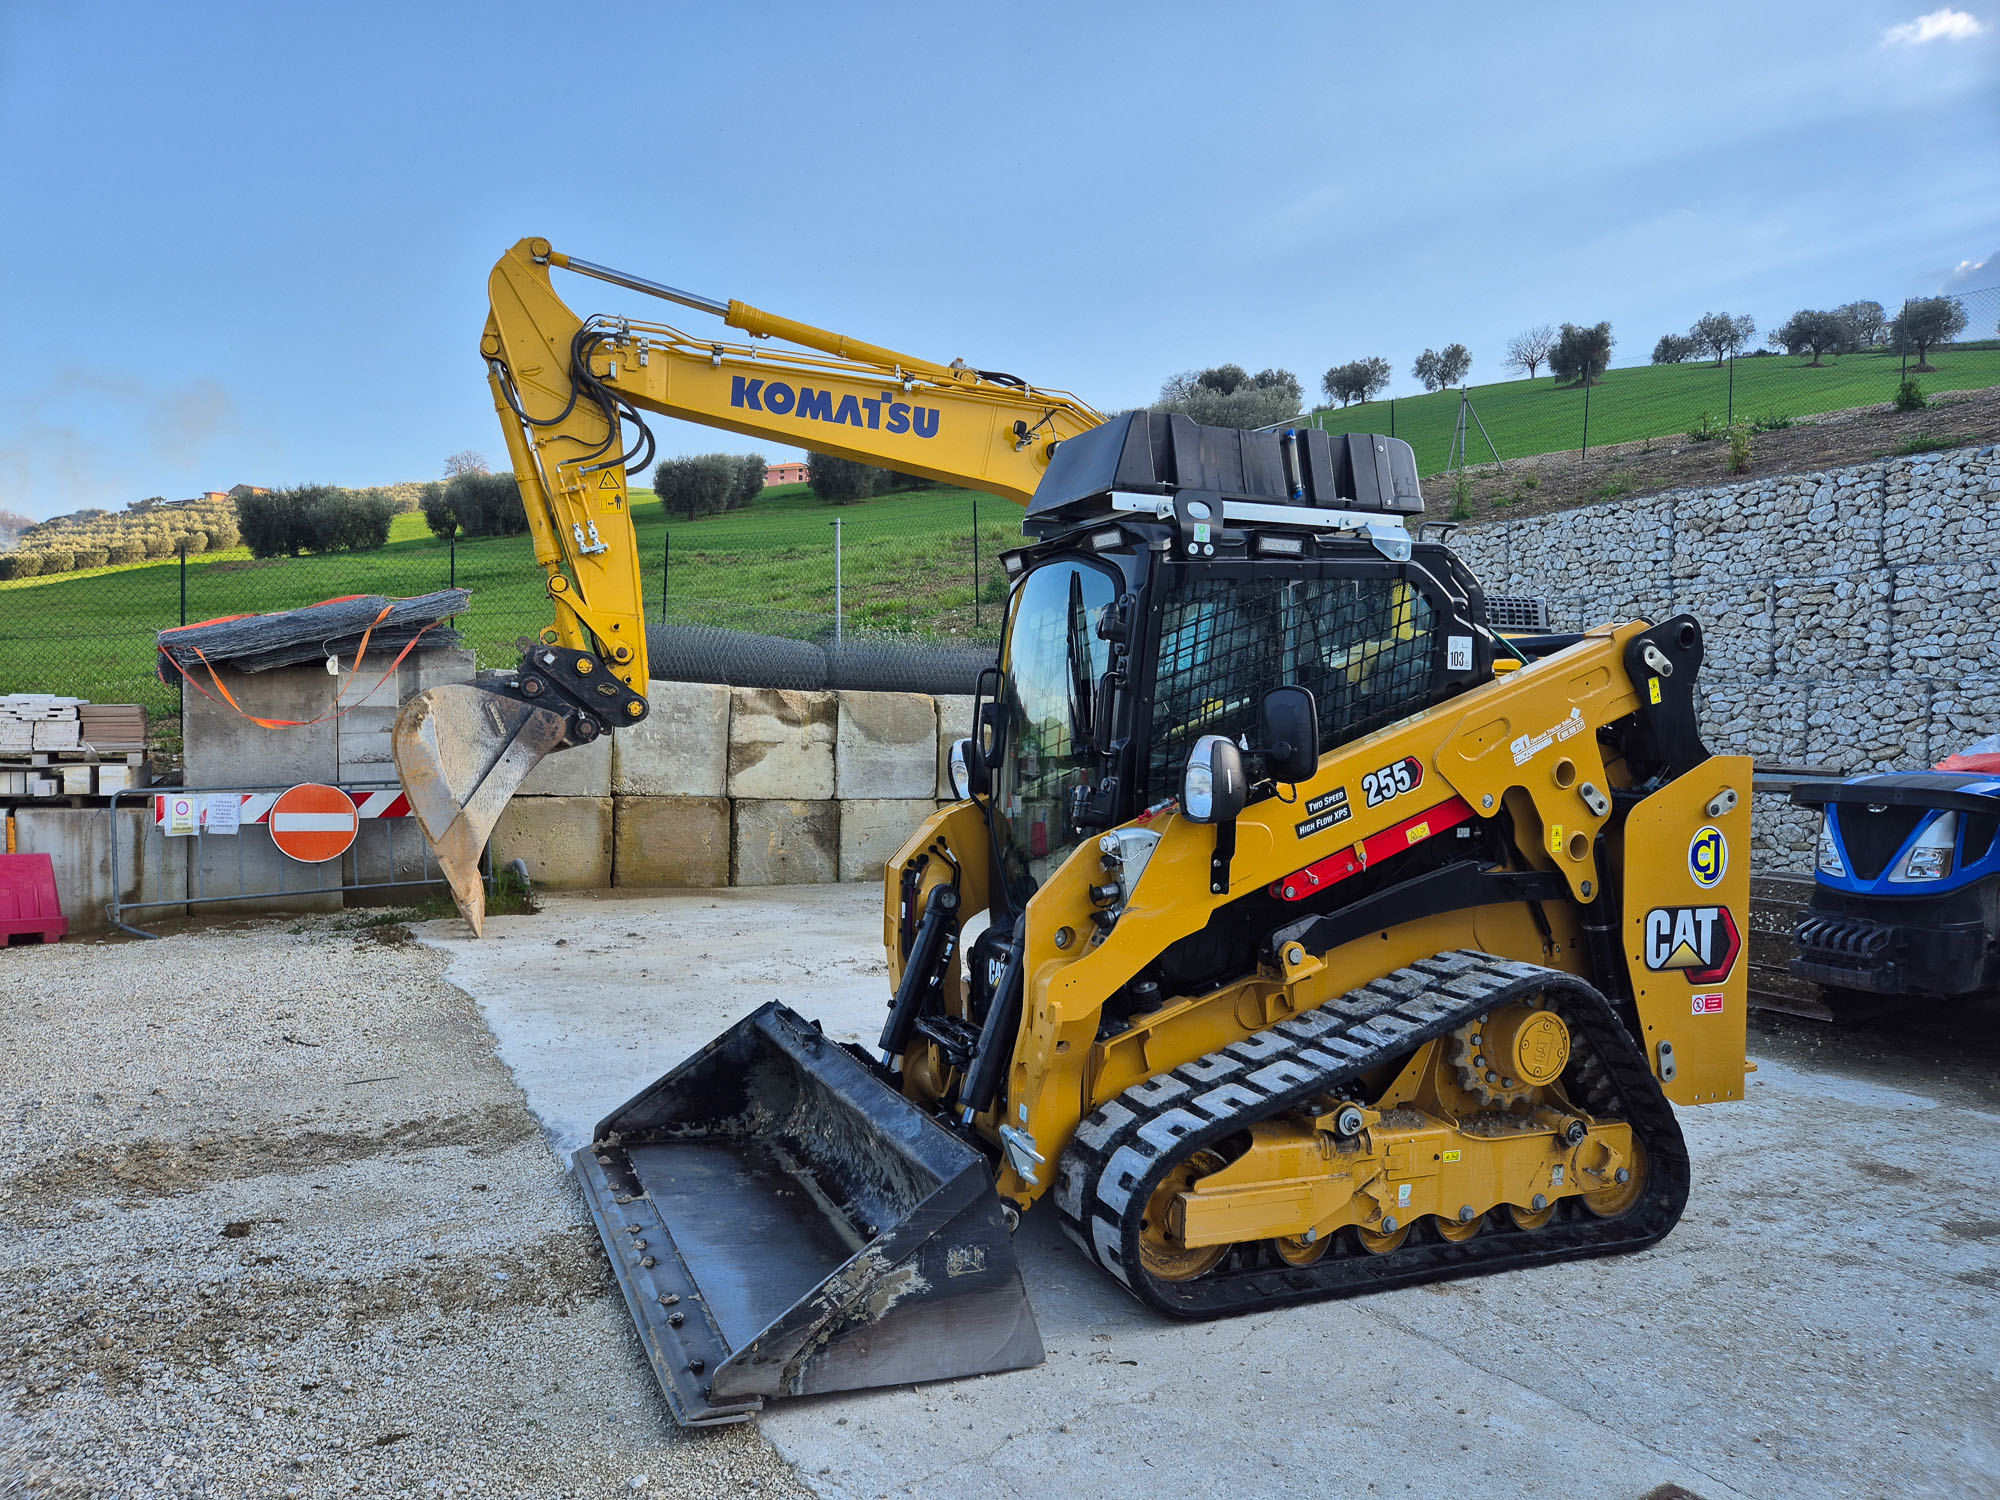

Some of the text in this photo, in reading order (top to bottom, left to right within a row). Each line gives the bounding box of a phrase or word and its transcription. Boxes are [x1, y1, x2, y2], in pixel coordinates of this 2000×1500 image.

[730, 375, 940, 439] KOMATSU
[1450, 651, 1464, 667] 103
[1363, 760, 1411, 806] 255
[1334, 807, 1348, 821] XPS
[1646, 907, 1719, 969] CAT
